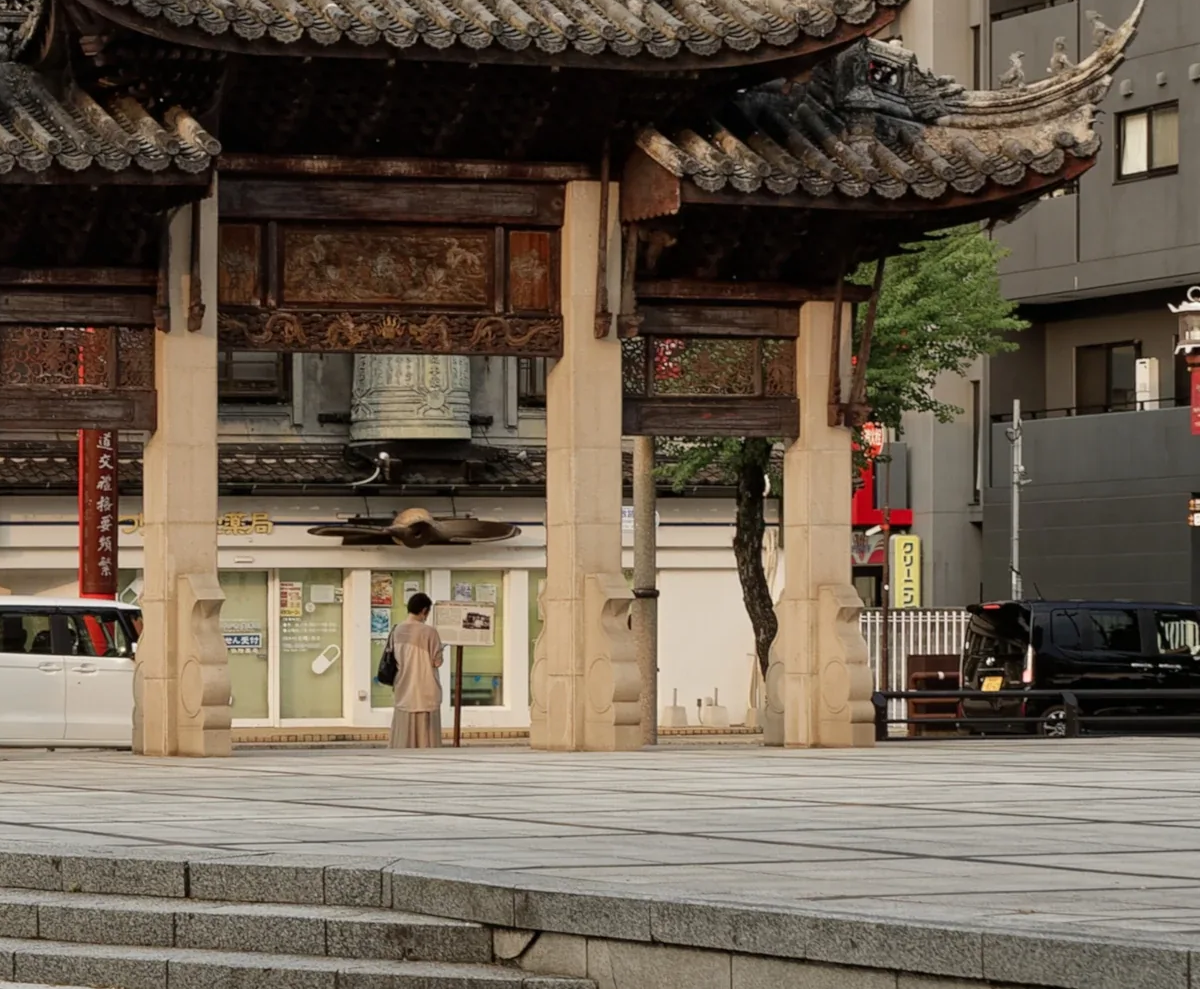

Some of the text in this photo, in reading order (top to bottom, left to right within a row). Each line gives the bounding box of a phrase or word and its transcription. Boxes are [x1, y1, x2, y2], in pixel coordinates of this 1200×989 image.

[903, 542, 917, 609] クリーニン
